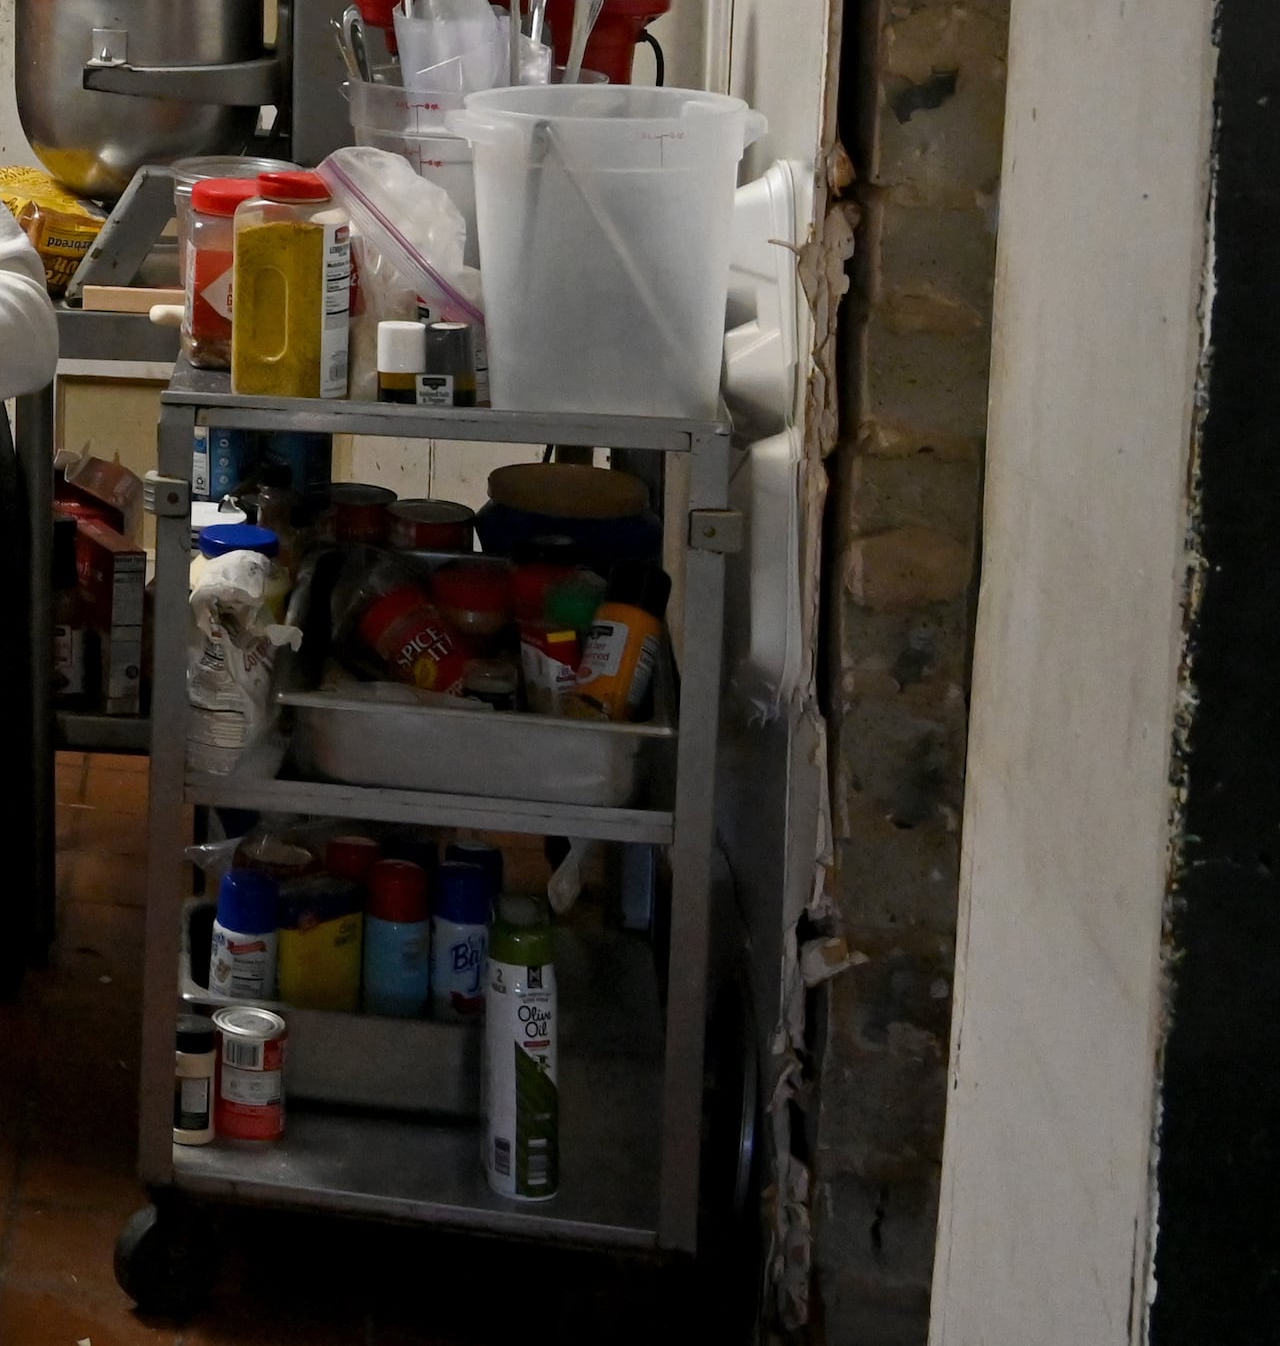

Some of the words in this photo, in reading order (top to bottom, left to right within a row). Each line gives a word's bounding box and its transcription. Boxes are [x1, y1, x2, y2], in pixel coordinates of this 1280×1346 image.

[47, 236, 92, 251] rbread
[396, 627, 443, 668] SPICE
[518, 1005, 552, 1022] Olive
[525, 1021, 548, 1038] Oil
